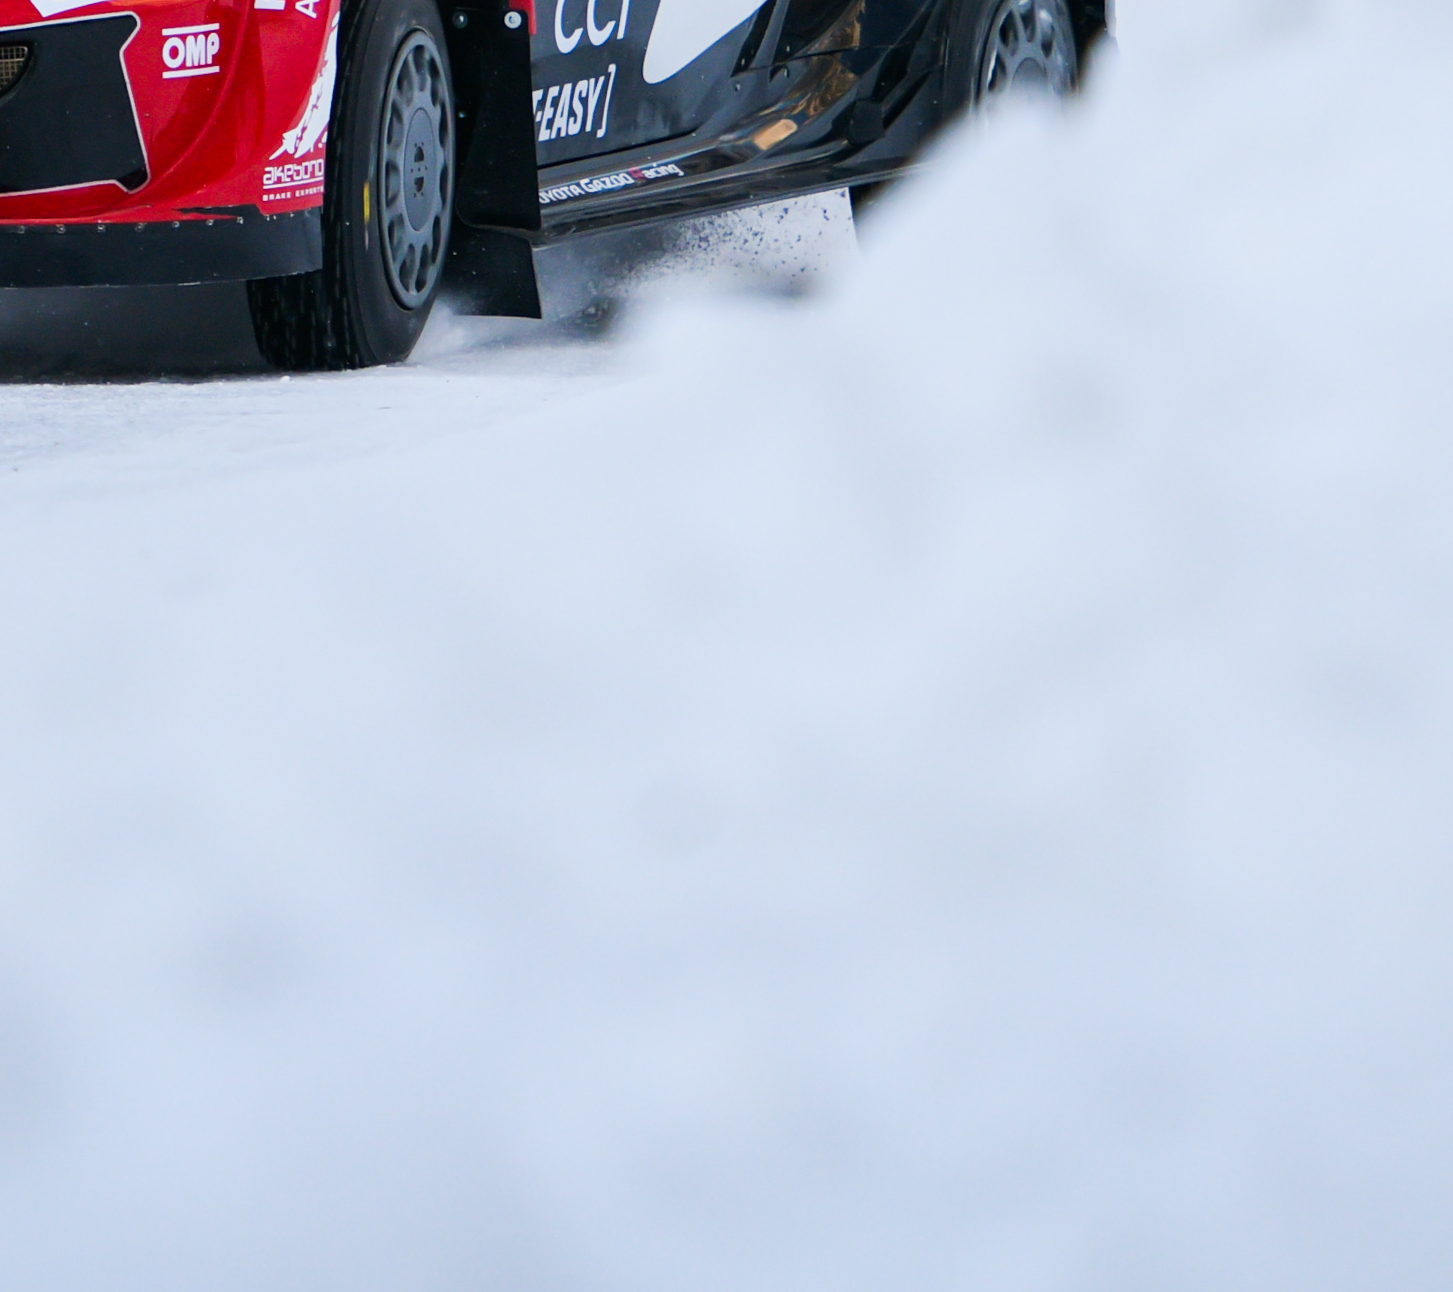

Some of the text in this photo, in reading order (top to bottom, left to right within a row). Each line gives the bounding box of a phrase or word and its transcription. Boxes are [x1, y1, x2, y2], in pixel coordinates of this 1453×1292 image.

[161, 32, 220, 69] OMP
[579, 172, 636, 194] GAZOO
[628, 162, 686, 181] Racing
